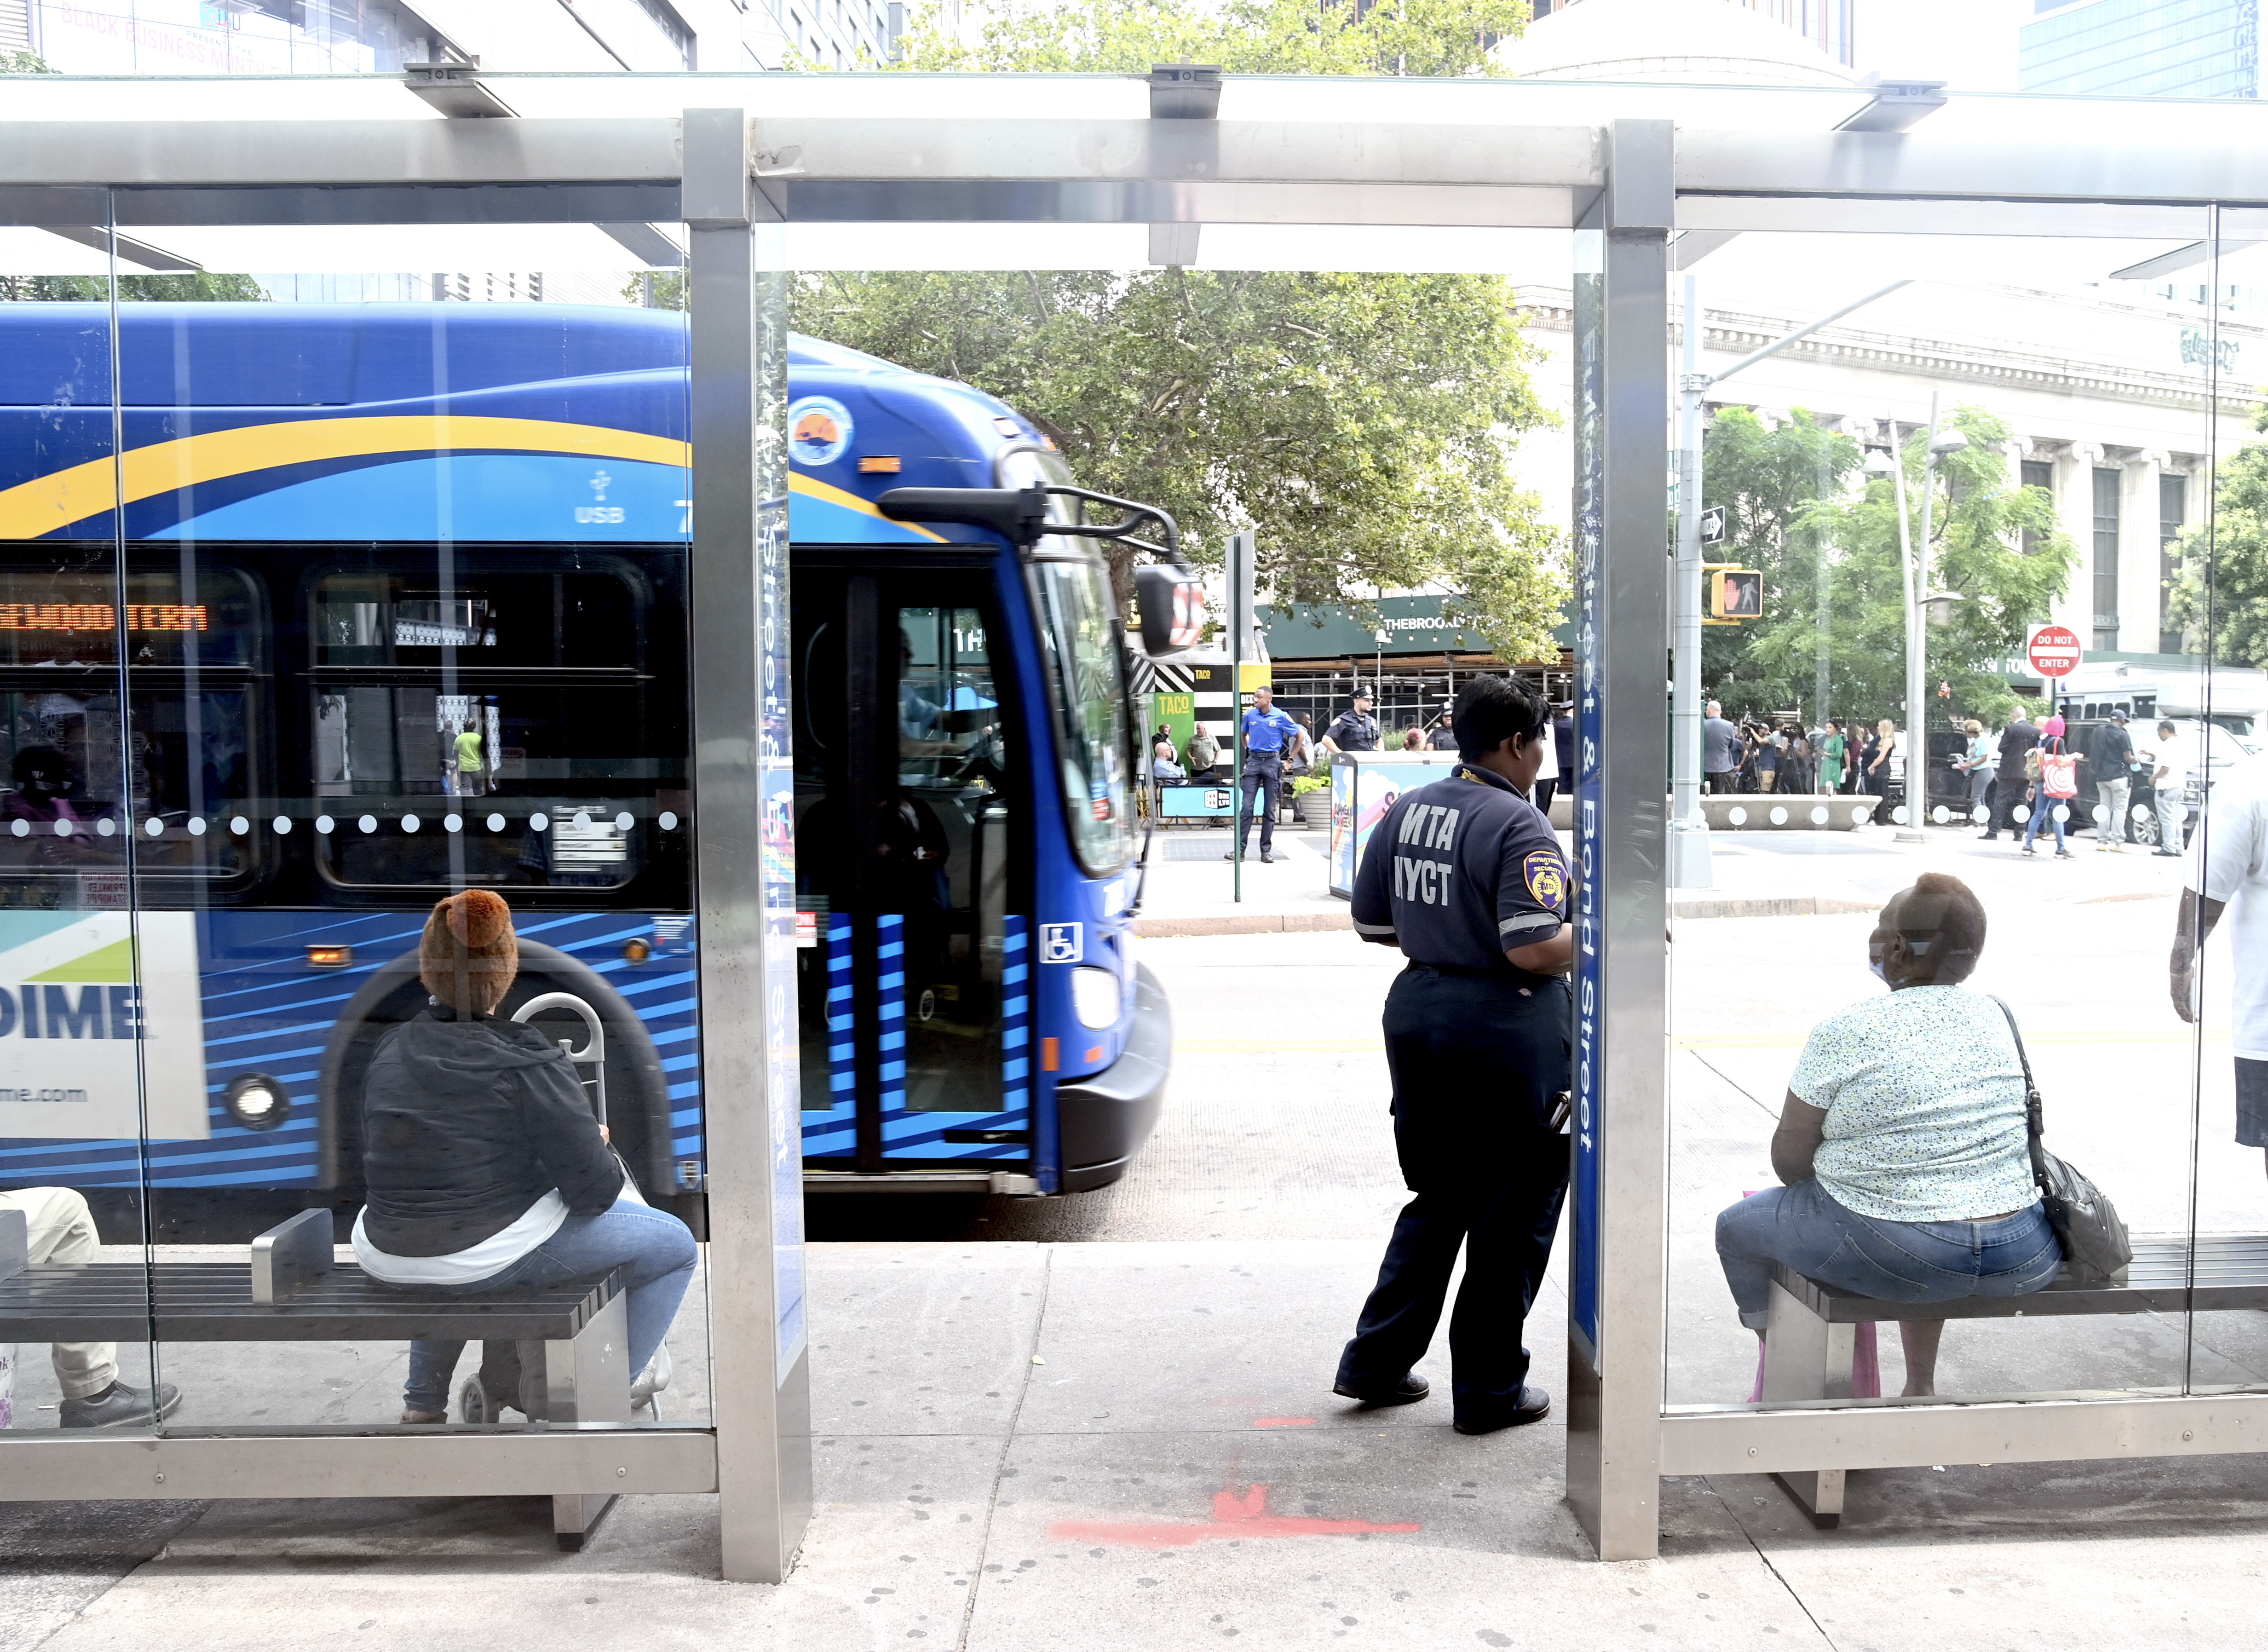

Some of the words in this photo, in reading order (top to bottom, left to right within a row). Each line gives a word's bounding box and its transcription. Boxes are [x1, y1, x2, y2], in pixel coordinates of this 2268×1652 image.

[62, 1, 119, 38] BLACK
[125, 21, 206, 63] BUSINESS
[236, 45, 253, 57] THE
[761, 313, 775, 502] Fulton
[1583, 327, 1596, 511] Fulton
[575, 507, 626, 524] USB
[1707, 519, 1718, 534] WAY
[123, 605, 207, 631] TERM
[764, 526, 777, 713] Street
[1583, 533, 1595, 714] Street
[2038, 635, 2051, 645] DO
[2054, 636, 2073, 645] NOT
[1195, 670, 1211, 679] TACO
[2039, 658, 2070, 668] ENTER
[1159, 696, 1190, 715] TACO
[1241, 694, 1255, 704] BEE
[1583, 735, 1594, 777] &
[1399, 802, 1460, 851] MTA
[769, 800, 781, 962] Bond
[1394, 856, 1452, 906] NYCT
[1533, 866, 1561, 875] SECURITY
[1541, 882, 1554, 890] MTA
[1583, 800, 1595, 956] Bond
[771, 984, 787, 1169] Street
[1580, 975, 1593, 1153] Street
